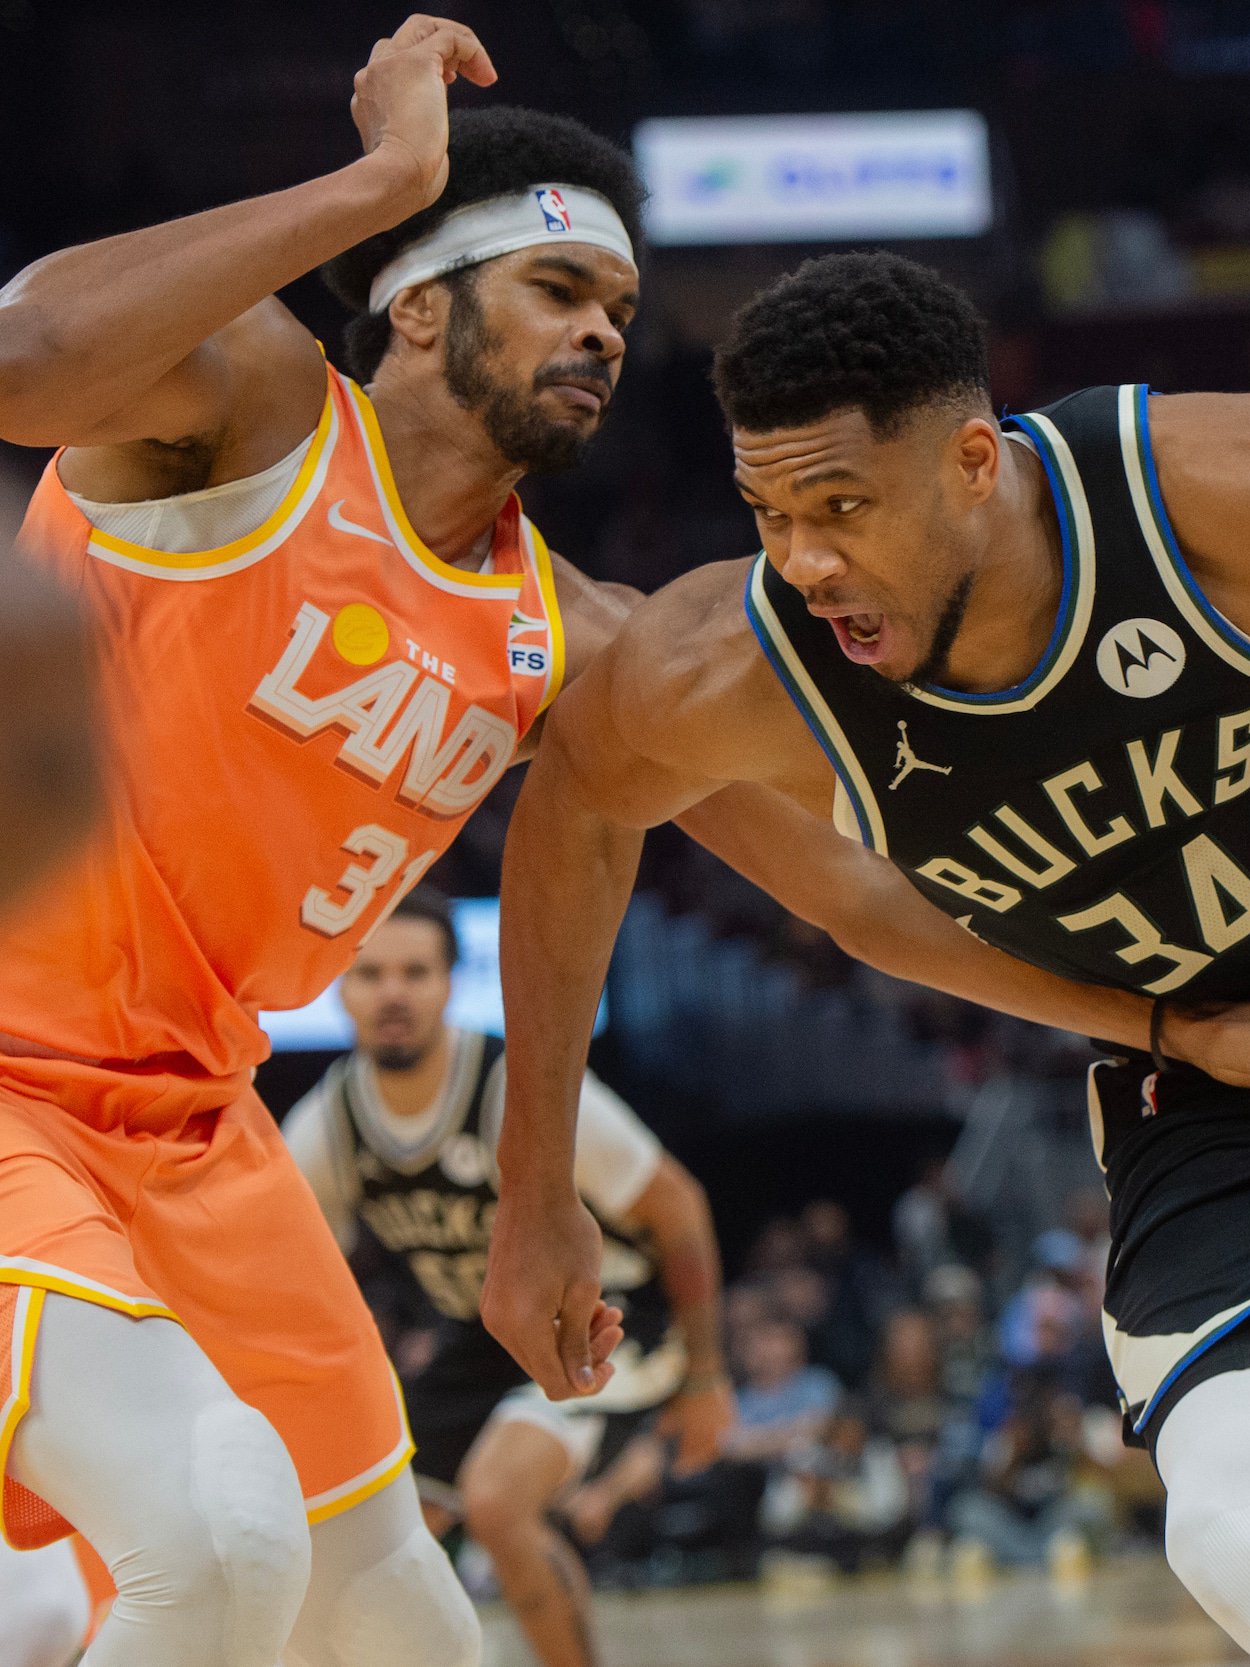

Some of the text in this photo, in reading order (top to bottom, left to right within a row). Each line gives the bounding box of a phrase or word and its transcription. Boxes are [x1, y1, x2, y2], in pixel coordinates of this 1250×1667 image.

[406, 638, 456, 686] THE
[507, 650, 545, 670] FS
[250, 600, 518, 818] LAND
